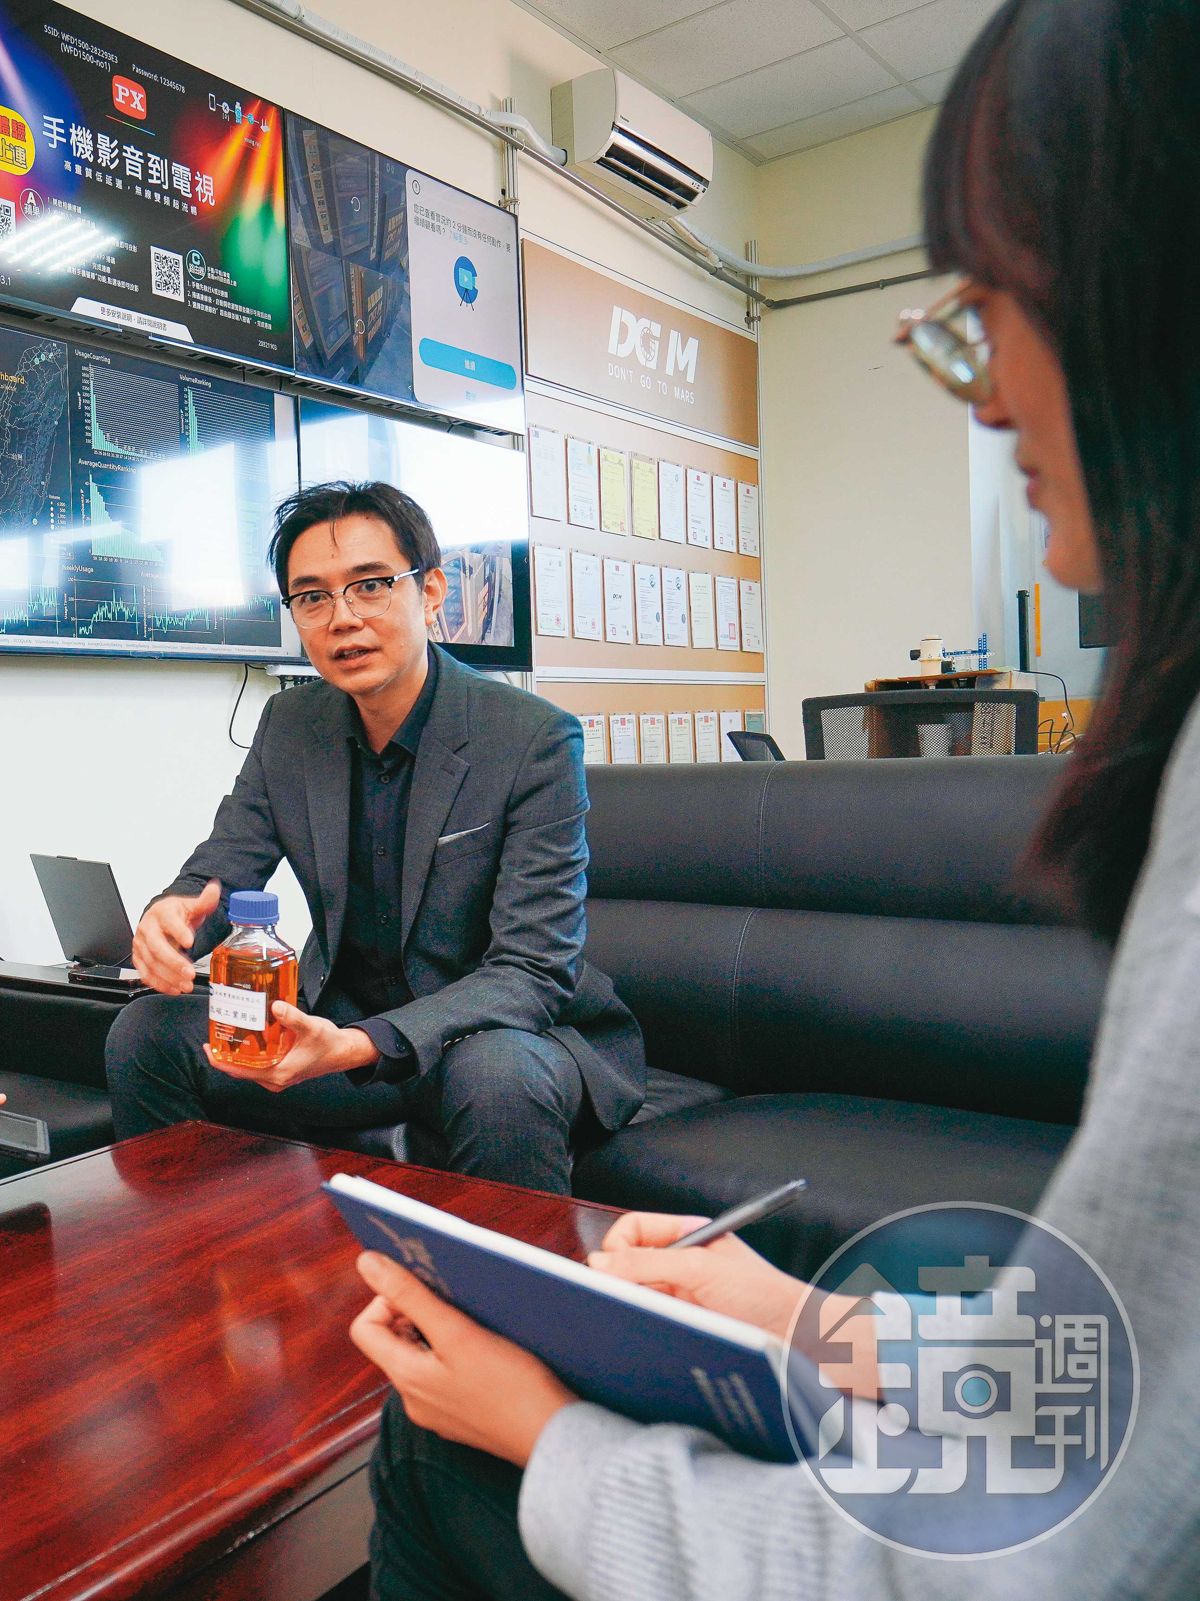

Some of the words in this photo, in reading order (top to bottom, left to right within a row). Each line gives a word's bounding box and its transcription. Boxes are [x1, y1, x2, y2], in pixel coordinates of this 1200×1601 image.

[44, 24, 60, 39] SSID:
[132, 63, 160, 82] Password:
[159, 76, 186, 94] 12345678
[114, 83, 145, 112] PX
[42, 114, 216, 207] 手機影音到電視
[26, 191, 37, 207] A
[607, 304, 699, 384] DGM
[607, 362, 634, 384] DON'T
[639, 374, 652, 390] GO
[657, 380, 668, 395] TO
[673, 386, 695, 405] MARS
